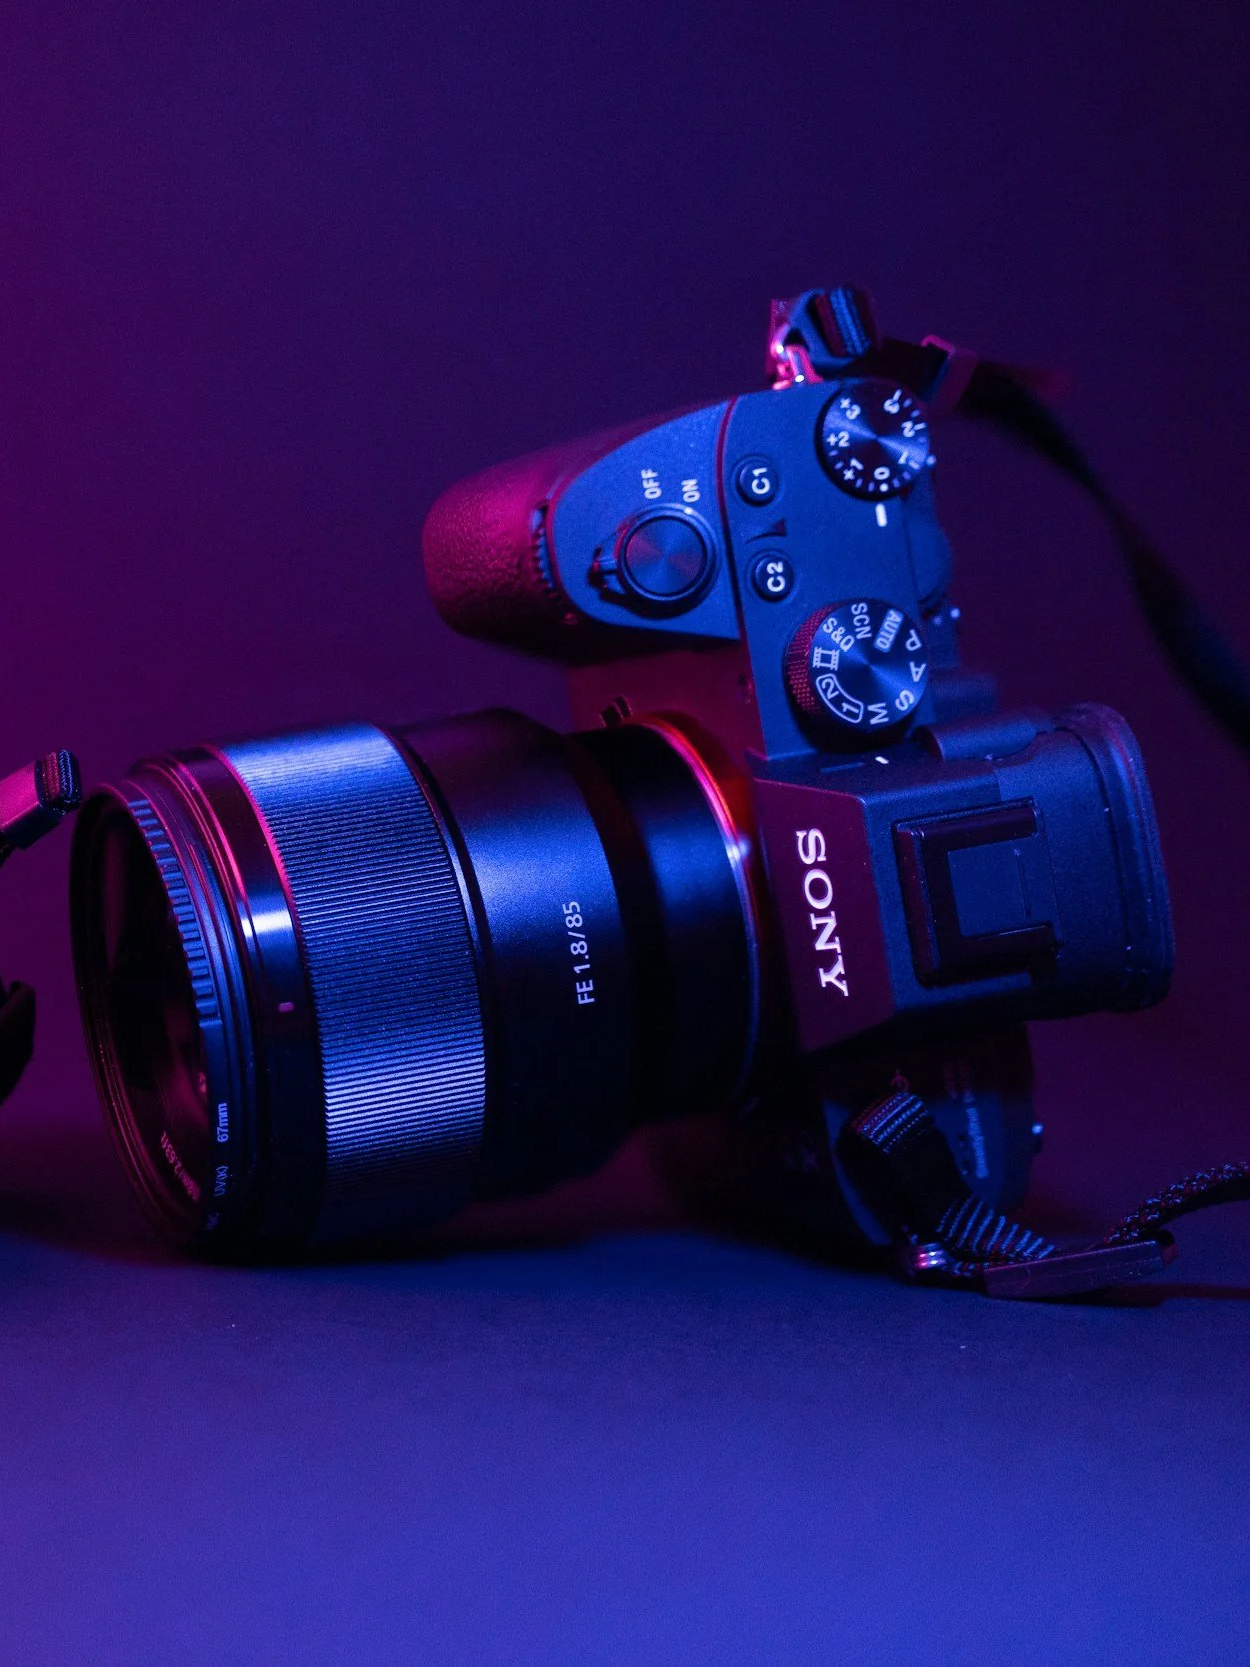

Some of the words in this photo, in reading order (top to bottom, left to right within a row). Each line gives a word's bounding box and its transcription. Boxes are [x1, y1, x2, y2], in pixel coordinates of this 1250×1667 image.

[826, 431, 850, 447] +2
[641, 468, 662, 499] OFF
[681, 479, 701, 502] ON
[751, 467, 771, 495] C1
[767, 560, 786, 592] C2
[822, 617, 855, 652] S&Q
[851, 602, 872, 640] SCN
[875, 609, 903, 652] AUTO
[905, 629, 923, 651] P
[909, 661, 927, 682] A
[822, 678, 839, 699] 2
[895, 690, 915, 711] S
[842, 702, 860, 715] 1
[867, 702, 890, 725] M
[796, 828, 849, 997] SONY
[562, 900, 592, 975] 1.8/85
[576, 978, 596, 1005] FE
[216, 1102, 230, 1143] 67mm
